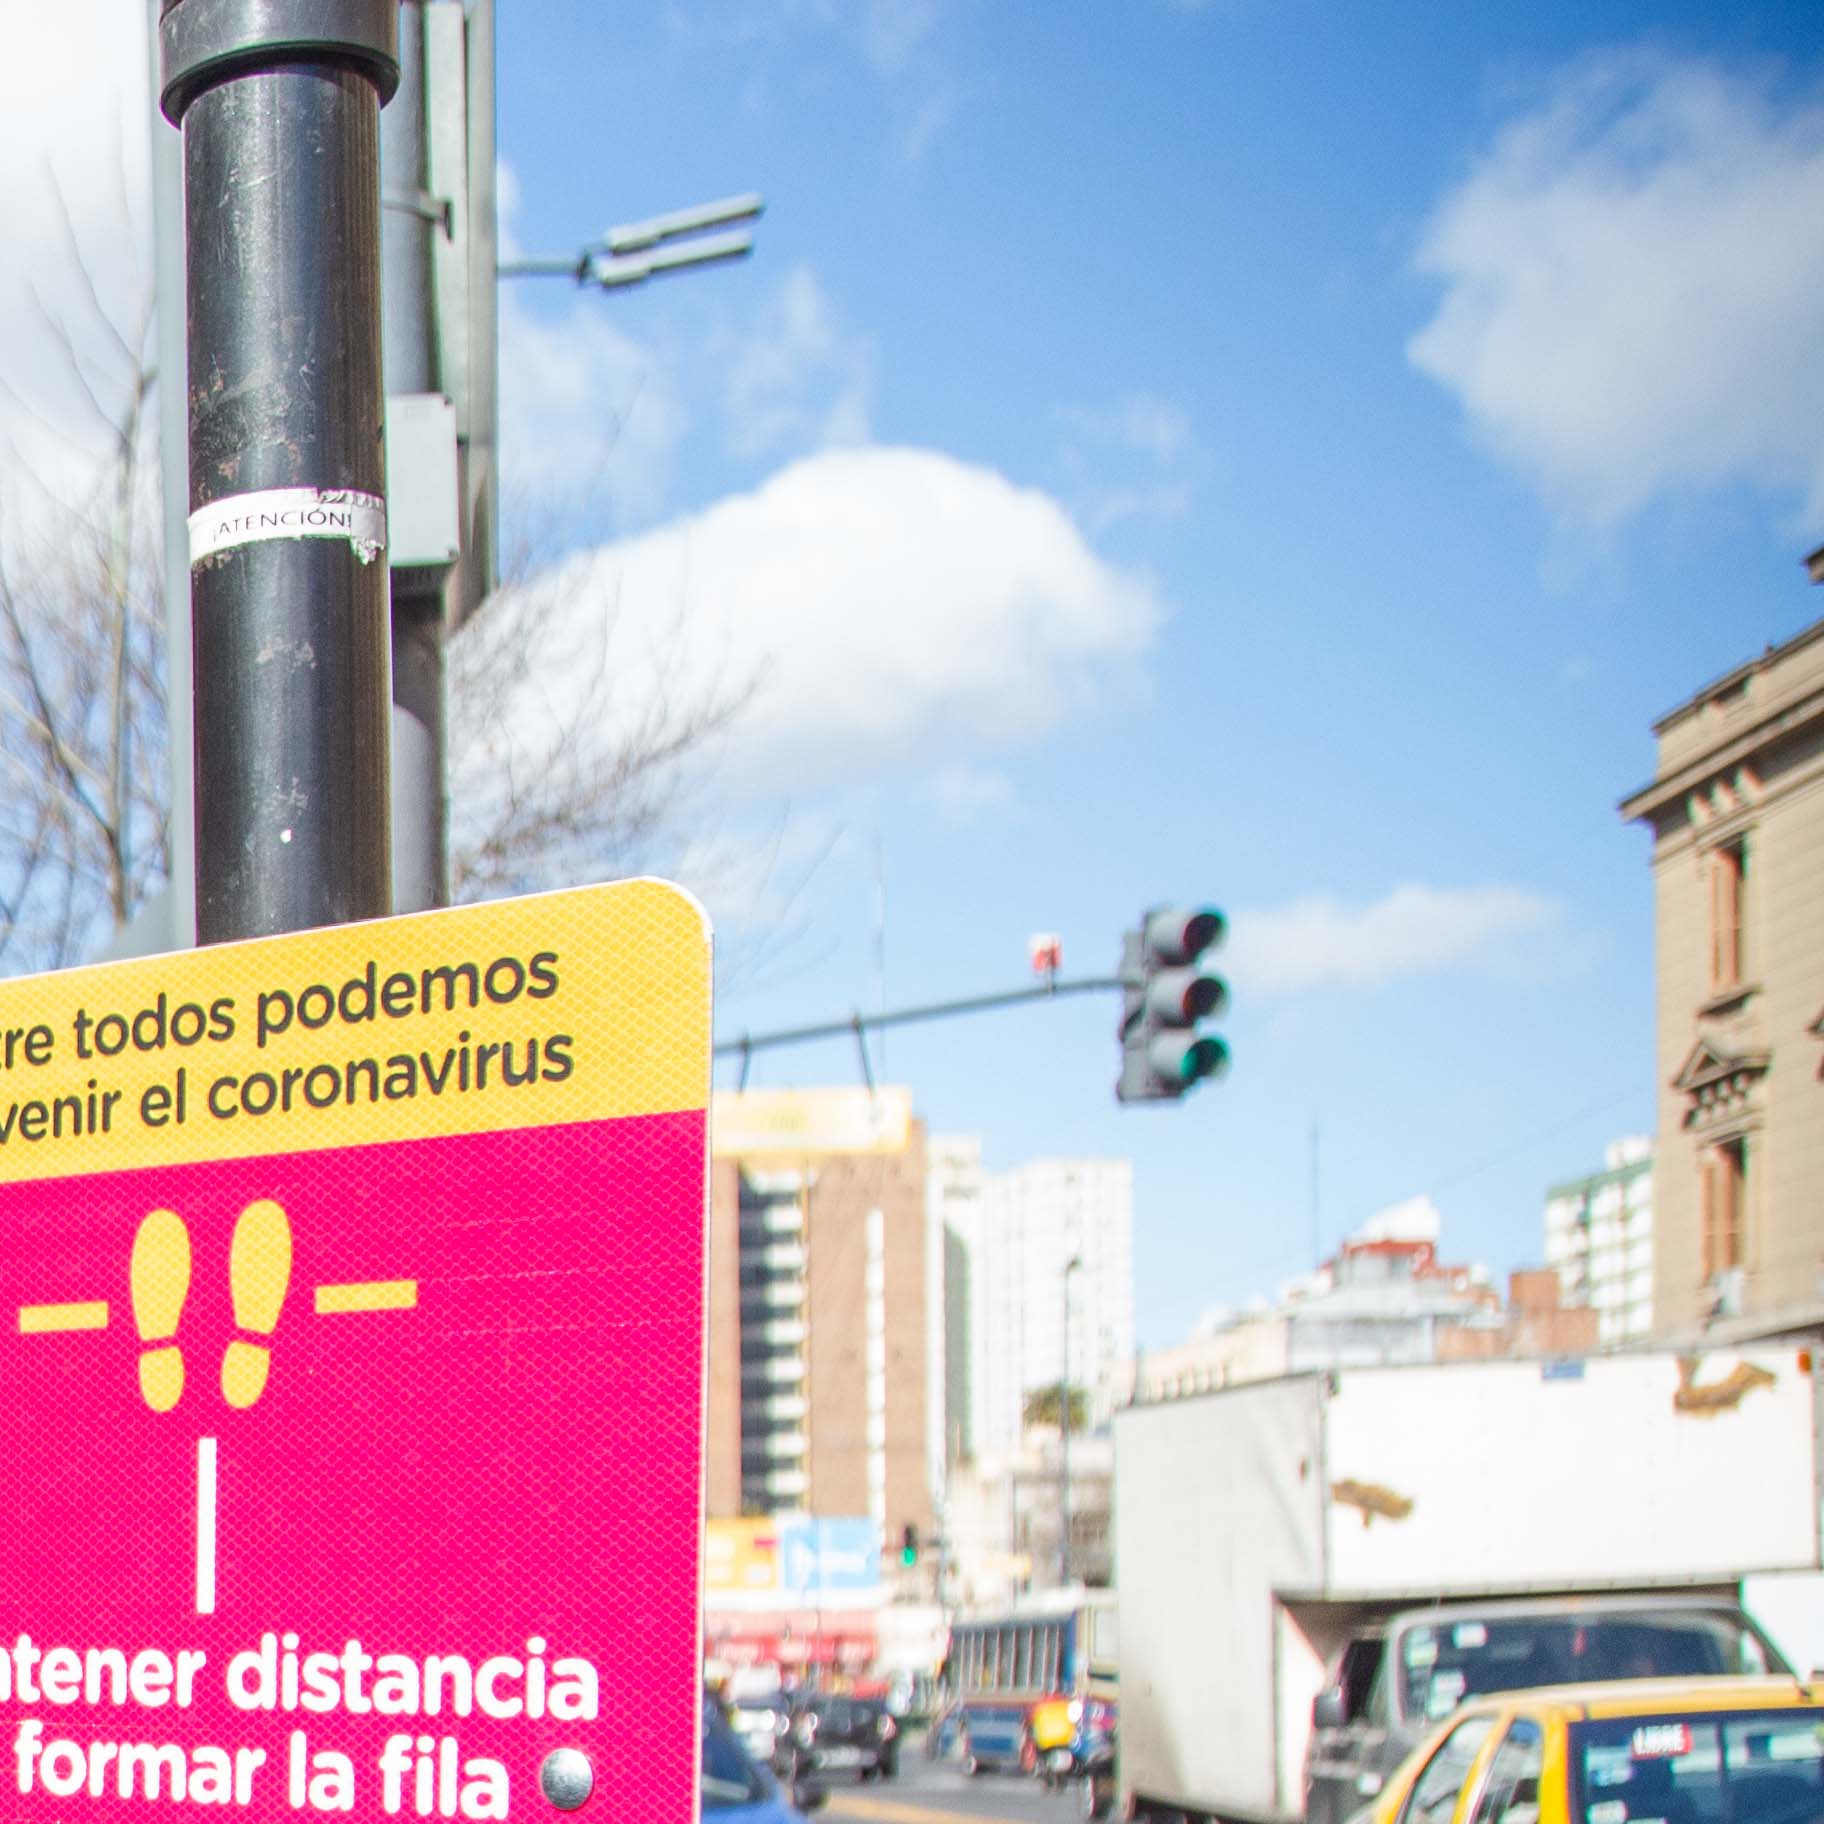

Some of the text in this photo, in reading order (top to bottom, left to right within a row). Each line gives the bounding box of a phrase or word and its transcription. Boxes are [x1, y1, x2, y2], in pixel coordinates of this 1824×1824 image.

[213, 509, 351, 542] ¡ATENCIÓN!
[74, 993, 234, 1057] todos
[258, 953, 557, 1046] podemos
[142, 1068, 185, 1126] el
[210, 1034, 572, 1118] coronavirus
[227, 1633, 598, 1721] distancia
[14, 1719, 266, 1805] formar
[289, 1730, 354, 1811] la
[379, 1734, 509, 1820] fila
